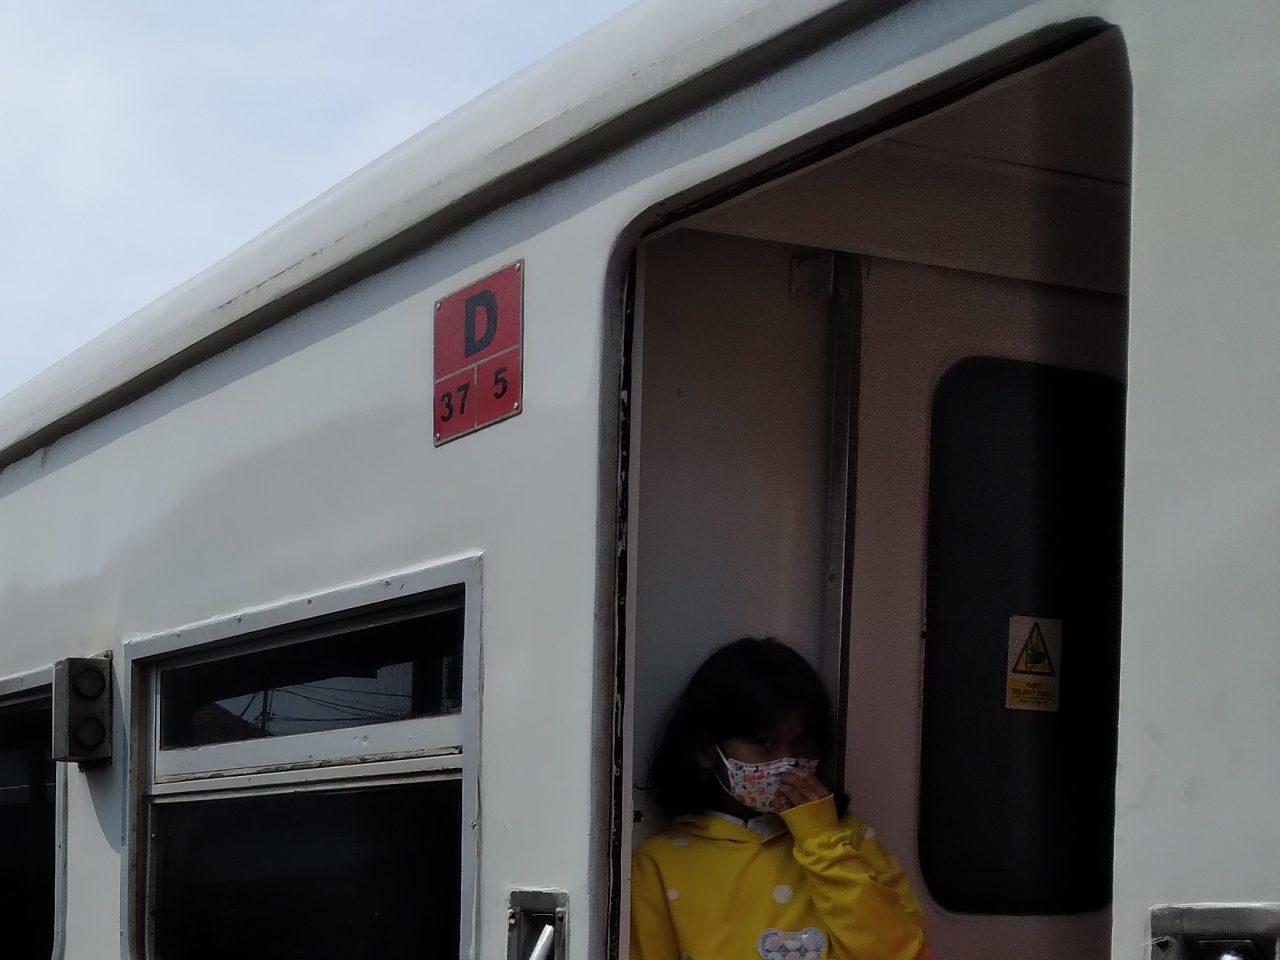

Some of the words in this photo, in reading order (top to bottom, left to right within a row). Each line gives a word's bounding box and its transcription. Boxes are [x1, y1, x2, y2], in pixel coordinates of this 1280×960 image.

[464, 290, 498, 359] D
[440, 381, 471, 422] 37
[493, 366, 509, 401] 5
